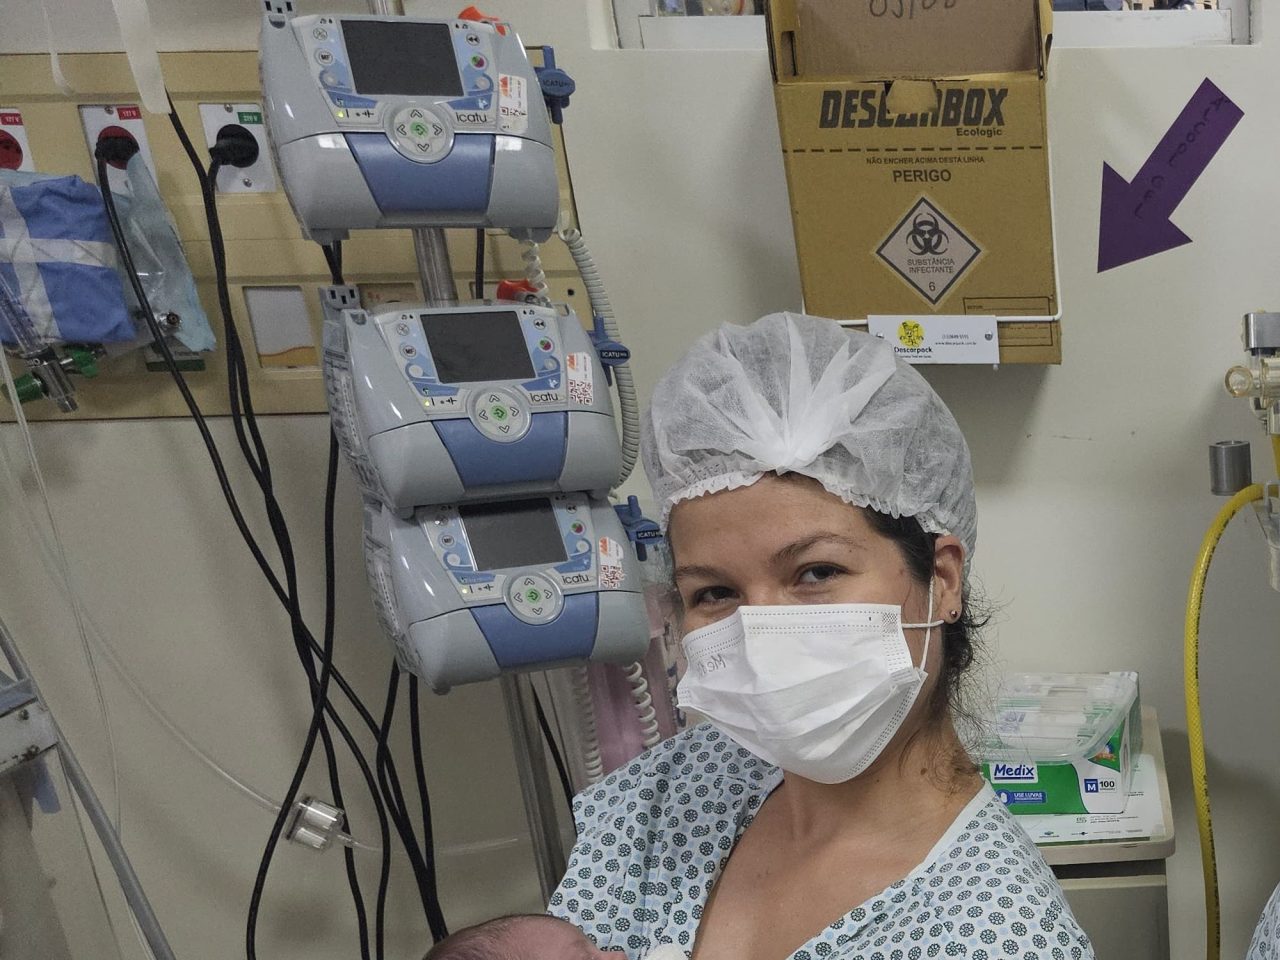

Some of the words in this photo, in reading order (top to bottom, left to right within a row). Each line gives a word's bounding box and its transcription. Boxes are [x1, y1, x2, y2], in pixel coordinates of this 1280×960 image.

[455, 111, 488, 124] icatu
[956, 127, 1003, 138] Ecologic
[866, 156, 882, 165] NÃO
[884, 157, 913, 165] ENCHER
[939, 156, 962, 164] DESTA
[963, 156, 985, 164] LINHA
[892, 168, 952, 183] PERIGO
[907, 257, 956, 267] SUBSTÂNCIA
[909, 266, 955, 275] INFECTANTE
[928, 281, 937, 292] 6
[530, 391, 559, 402] icatu
[562, 574, 590, 584] icatu
[993, 763, 1035, 777] Medix
[1087, 783, 1096, 791] M
[1099, 780, 1115, 788] 100
